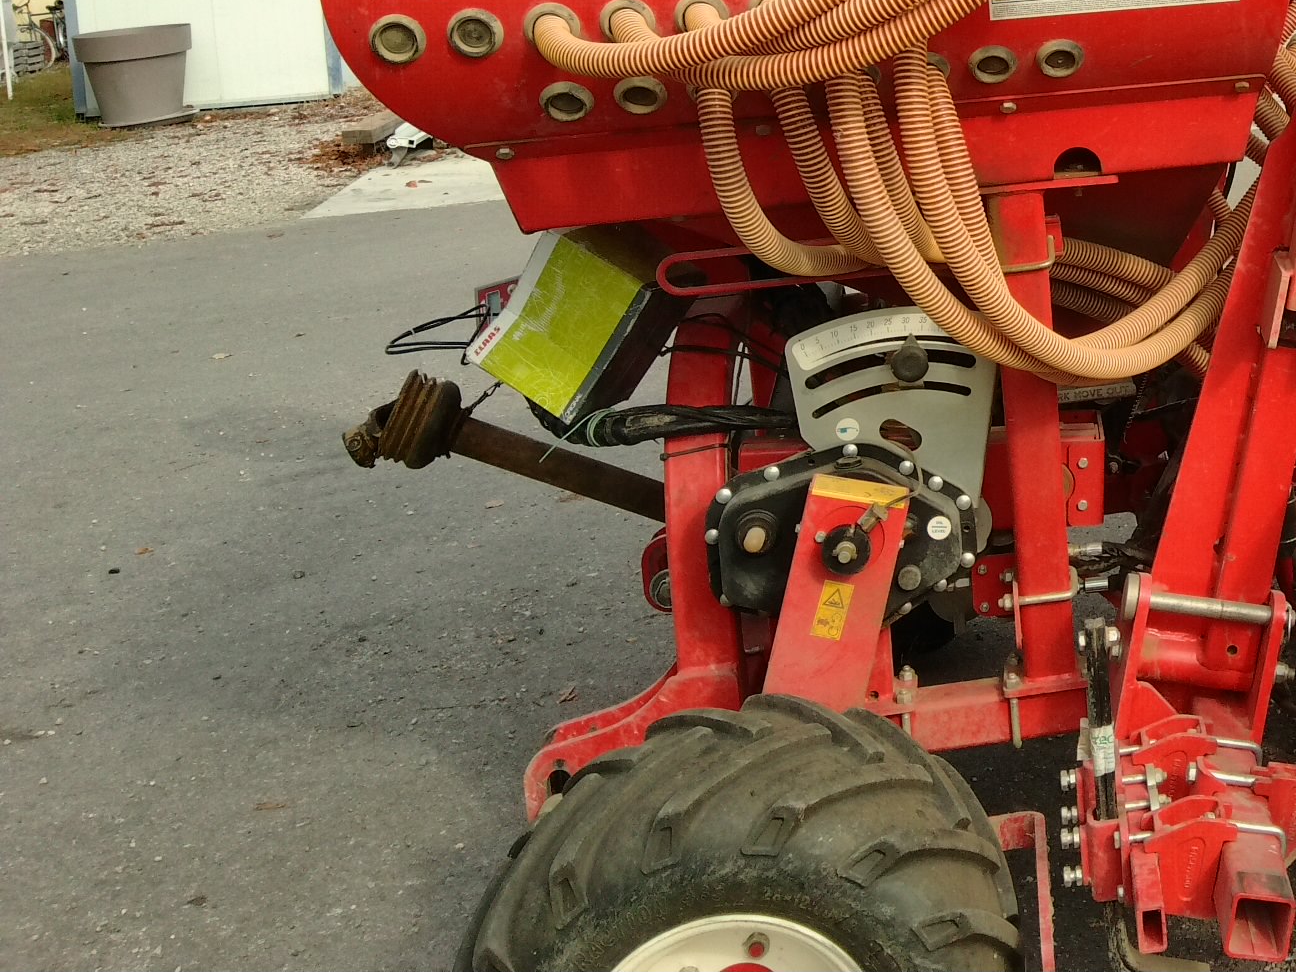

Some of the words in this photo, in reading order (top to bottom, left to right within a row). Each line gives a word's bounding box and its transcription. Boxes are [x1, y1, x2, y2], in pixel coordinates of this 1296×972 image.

[830, 330, 839, 338] 10
[850, 324, 858, 332] 15
[866, 320, 875, 328] 20
[883, 317, 893, 326] 25
[901, 316, 910, 324] 30
[918, 316, 928, 324] 35
[1073, 388, 1103, 399] MOVE
[1106, 385, 1129, 396] OUT
